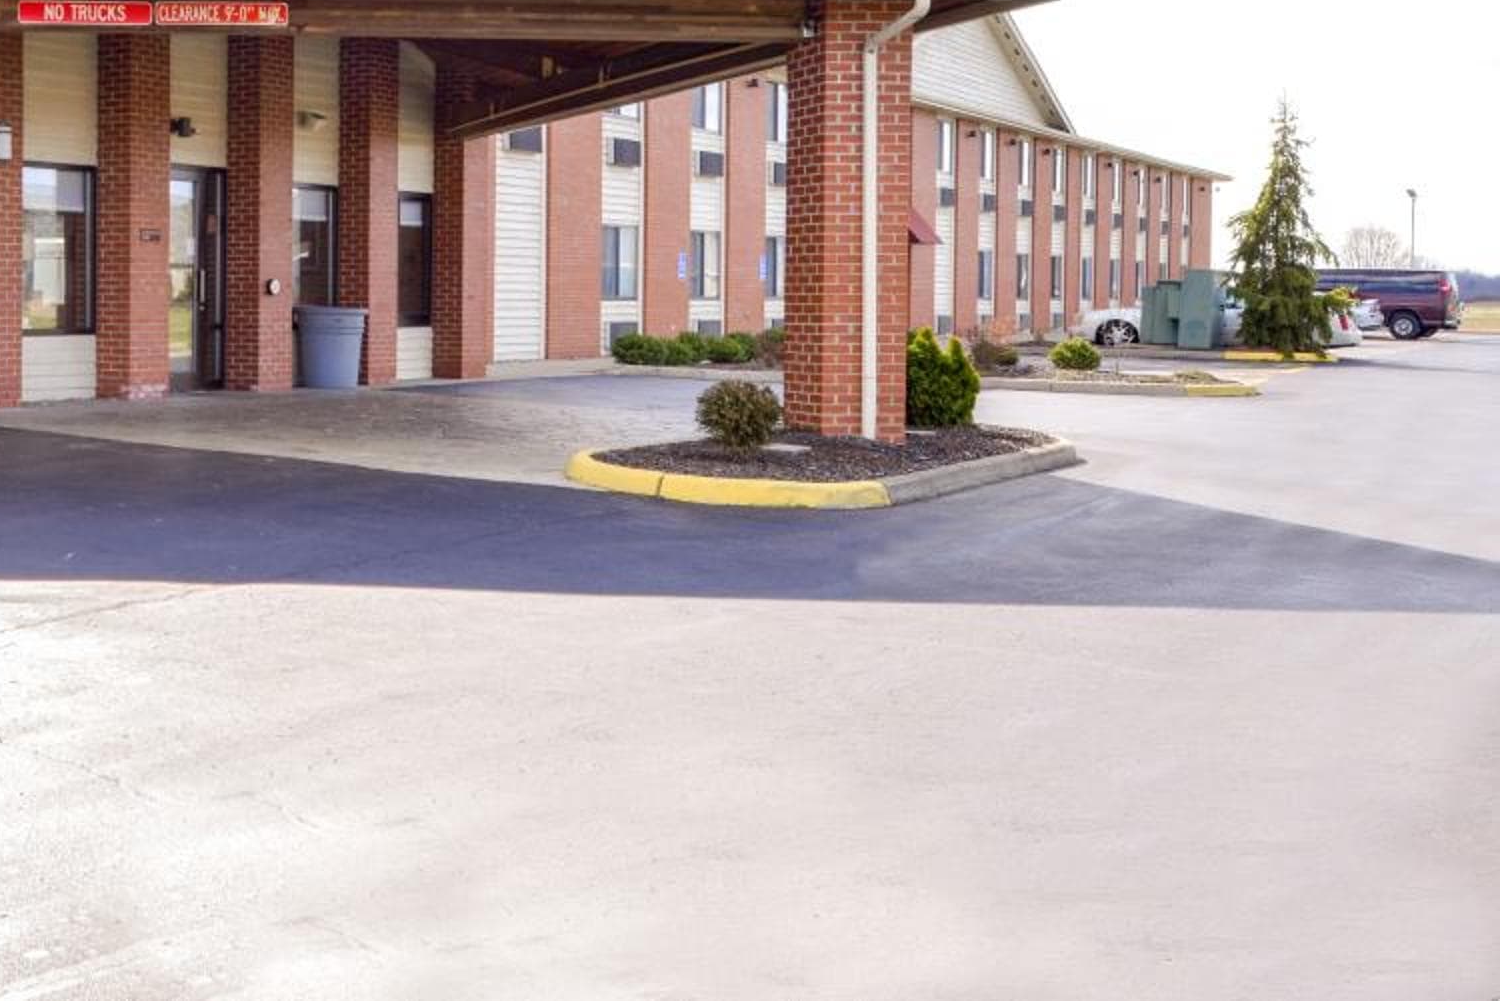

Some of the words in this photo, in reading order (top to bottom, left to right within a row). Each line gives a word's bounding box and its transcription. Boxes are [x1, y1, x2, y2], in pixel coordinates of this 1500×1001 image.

[44, 3, 64, 21] NO
[70, 4, 127, 22] TRUCKS
[159, 4, 220, 22] CLEARANCE
